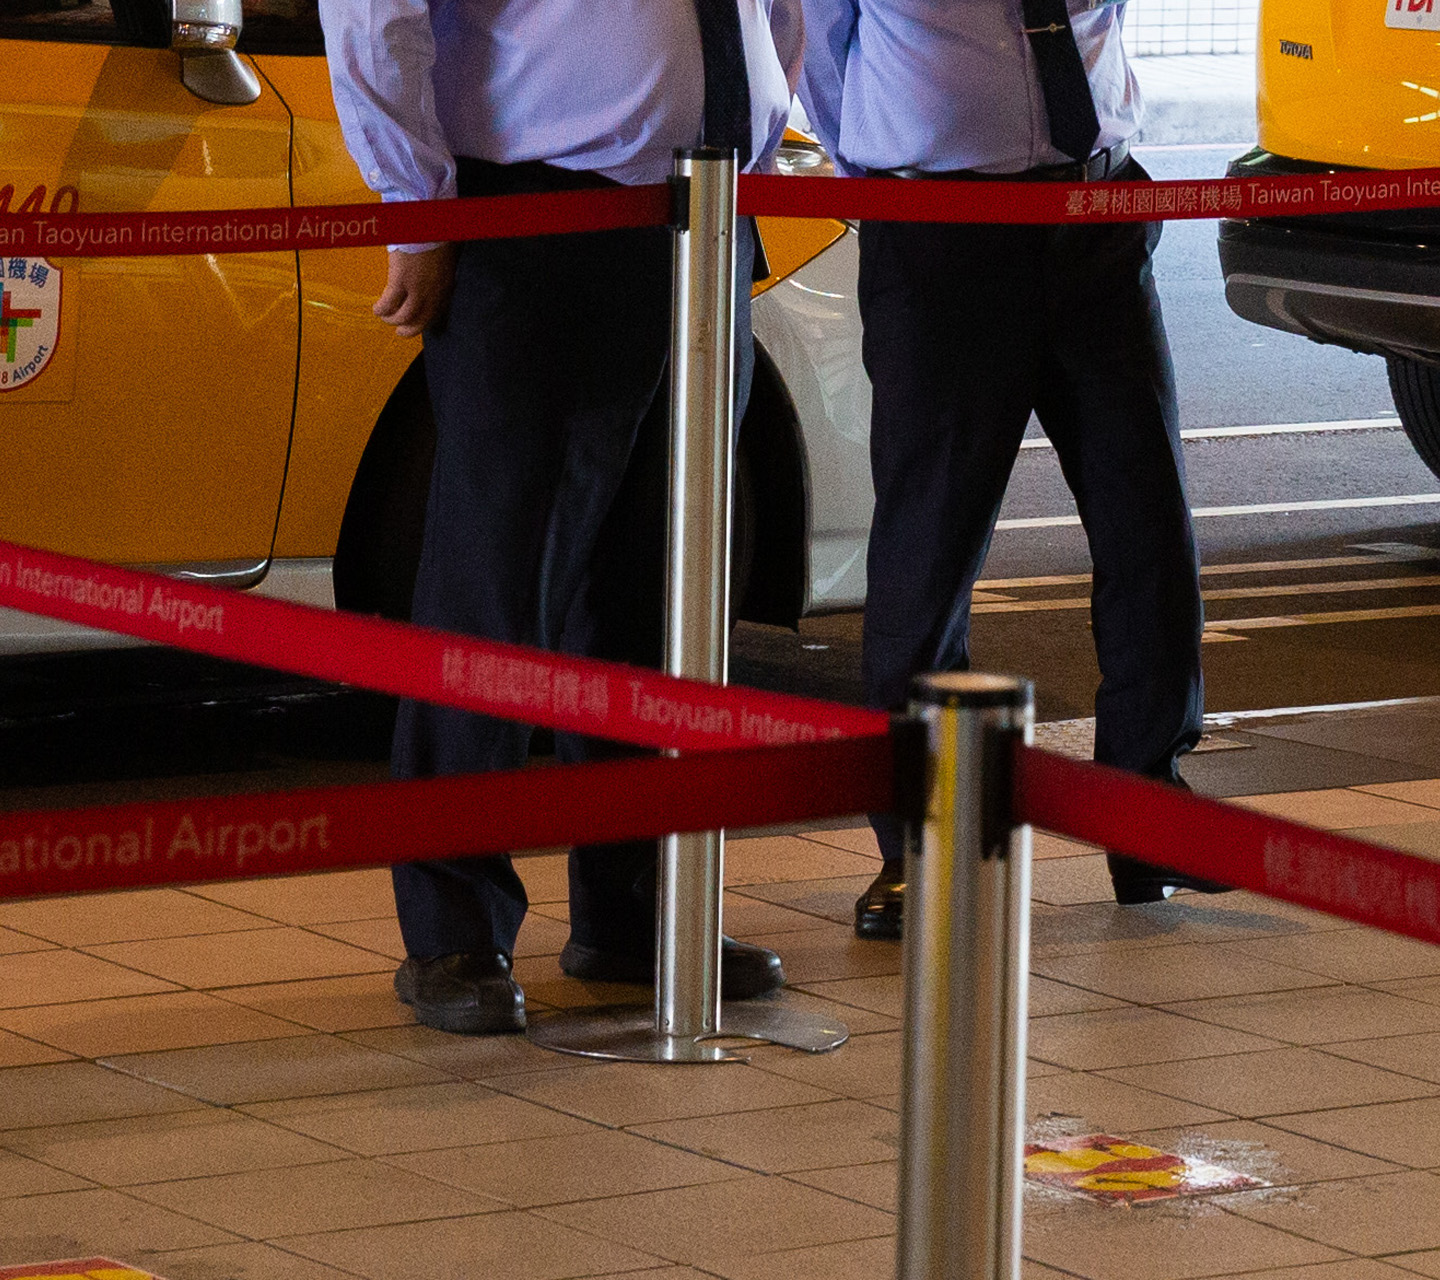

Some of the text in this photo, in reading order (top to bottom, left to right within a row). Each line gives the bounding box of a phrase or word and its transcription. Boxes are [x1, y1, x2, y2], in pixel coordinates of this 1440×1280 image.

[1064, 184, 1243, 217] 臺灣桃園國際機場
[1247, 182, 1316, 206] Taiwan
[1319, 179, 1401, 206] Taoyuan
[33, 219, 133, 251] Taoyuan
[141, 216, 290, 242] International
[295, 214, 380, 243] Airport
[12, 343, 49, 383] Airport
[15, 555, 146, 616] International
[147, 585, 225, 635] Airport
[629, 679, 735, 737] Taoyuan
[165, 811, 333, 868] Airport
